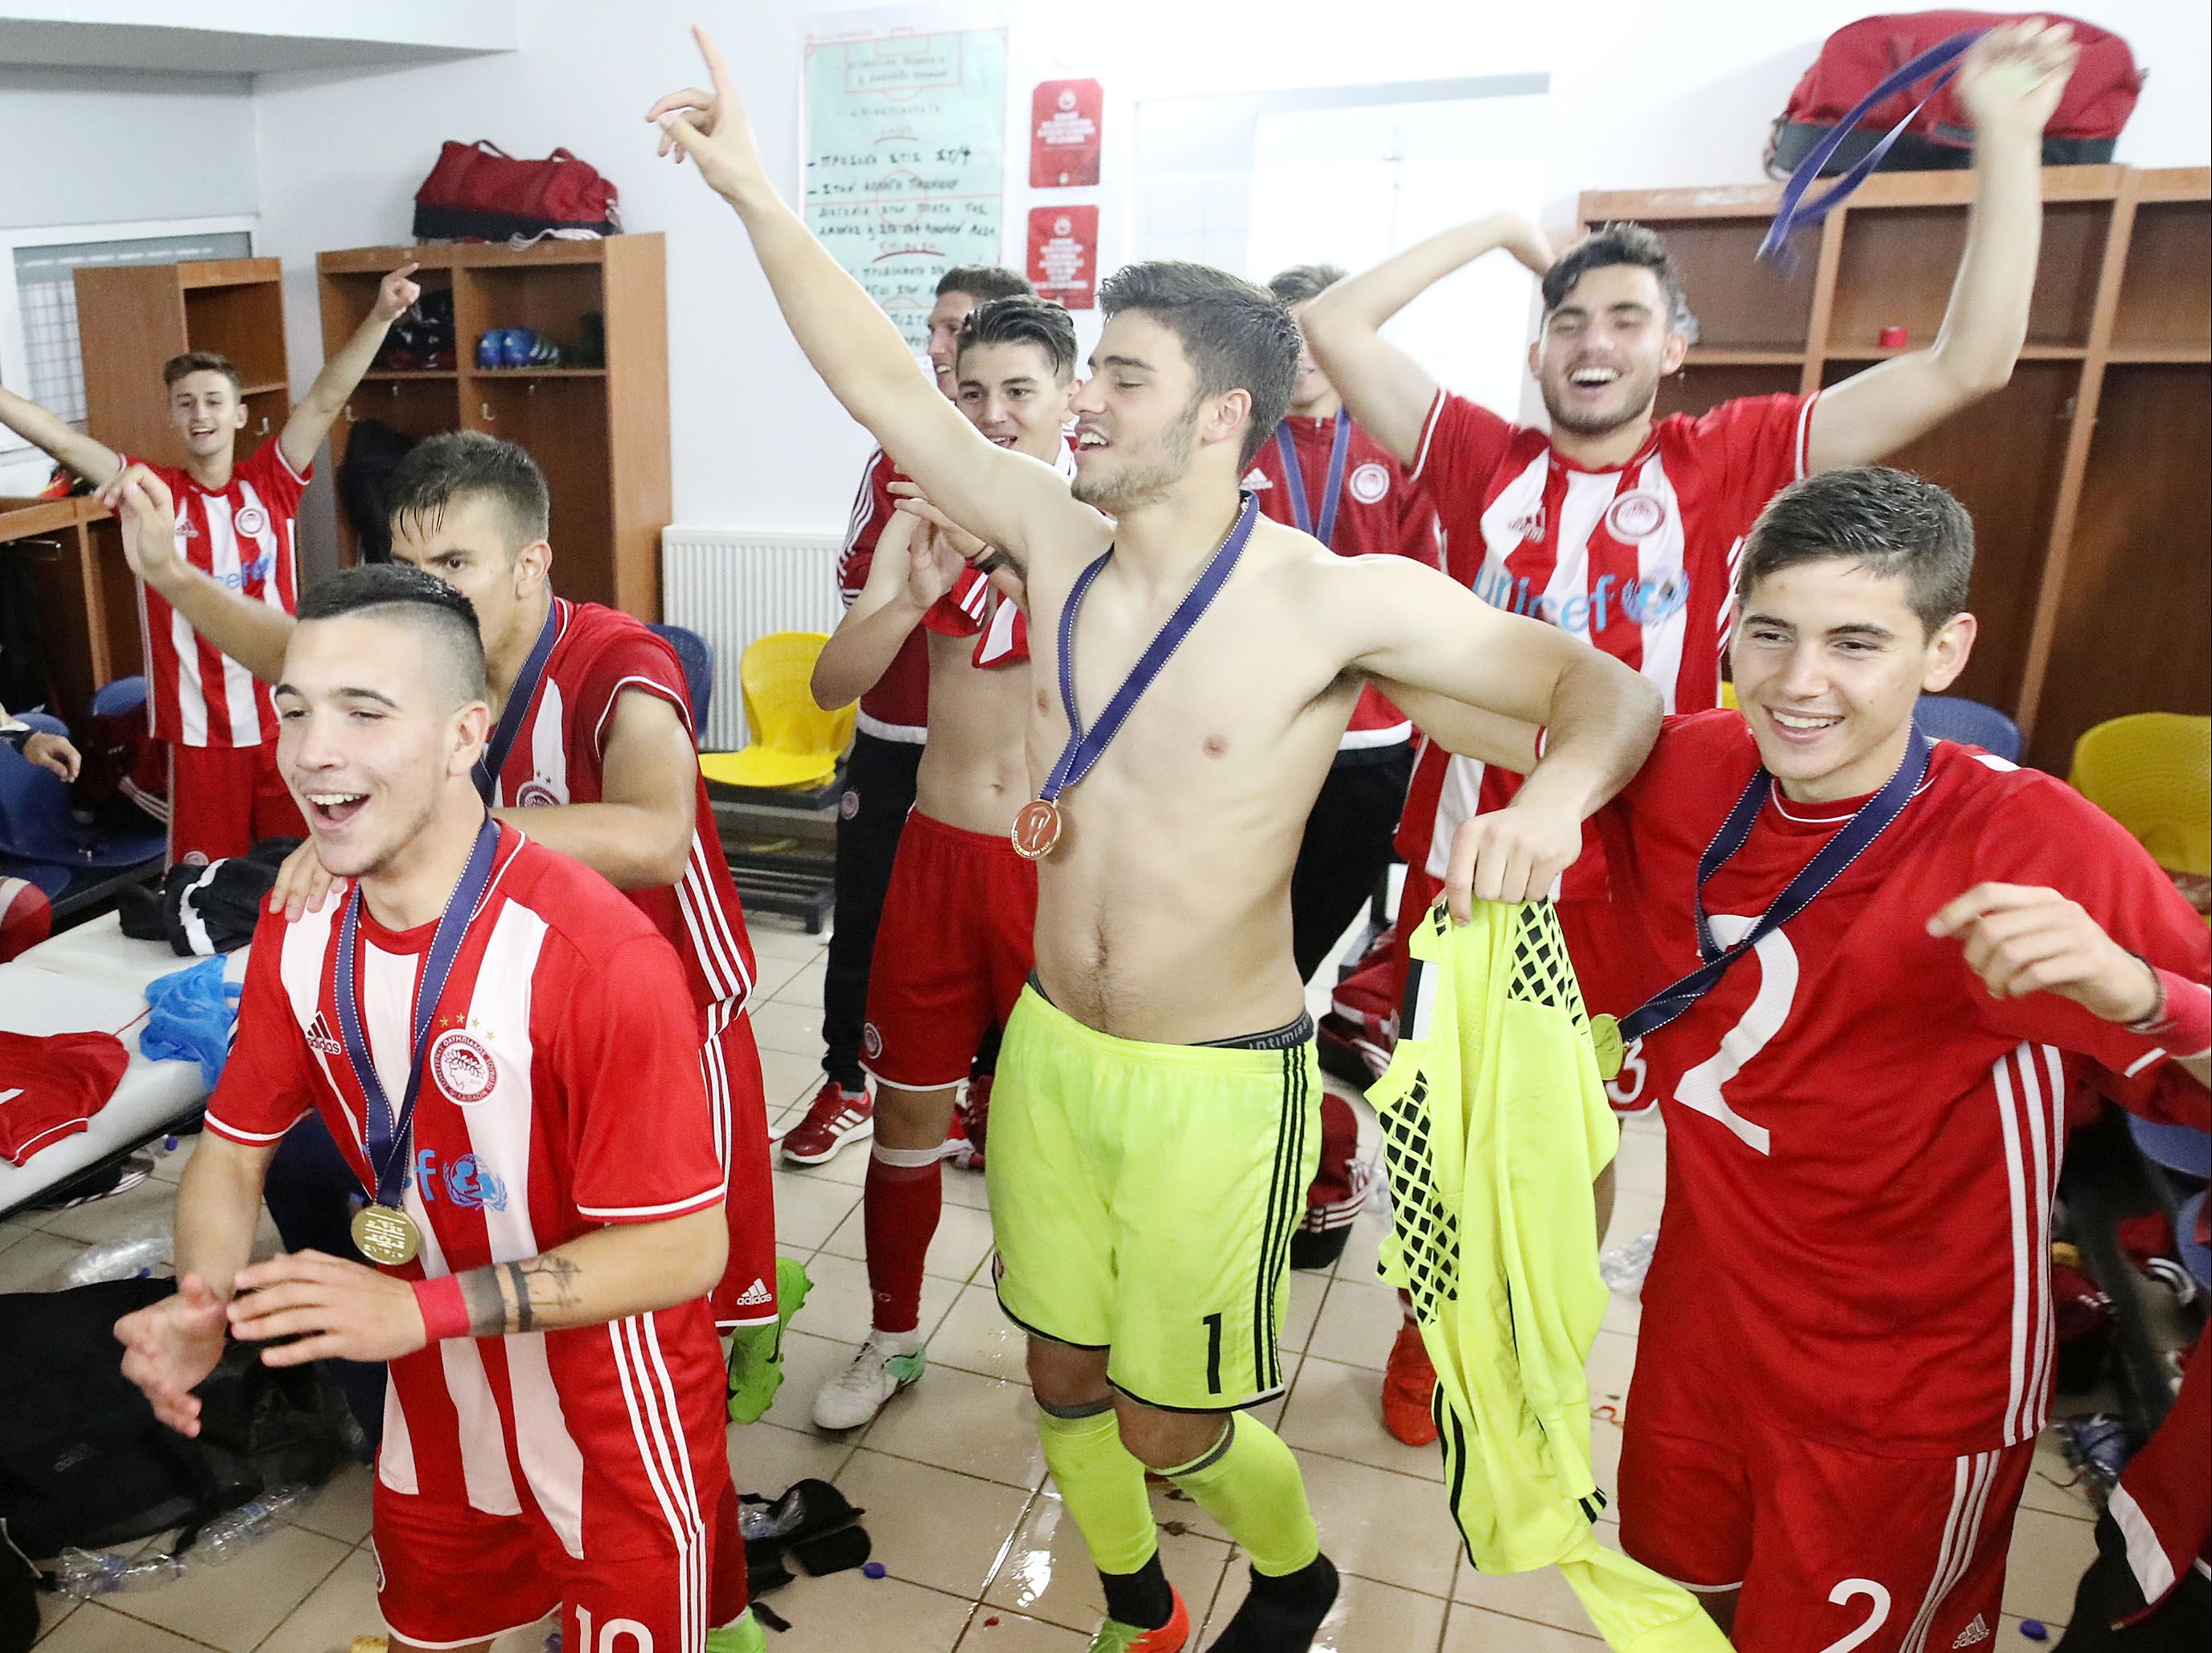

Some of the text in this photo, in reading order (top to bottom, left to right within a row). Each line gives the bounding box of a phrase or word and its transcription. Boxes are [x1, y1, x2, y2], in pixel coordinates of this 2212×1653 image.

[1673, 914, 1799, 1156] 2
[736, 1292, 773, 1306] adidas
[1203, 1312, 1222, 1395] 1
[1818, 1577, 1892, 1653] 2
[1951, 1627, 1991, 1650] adidas
